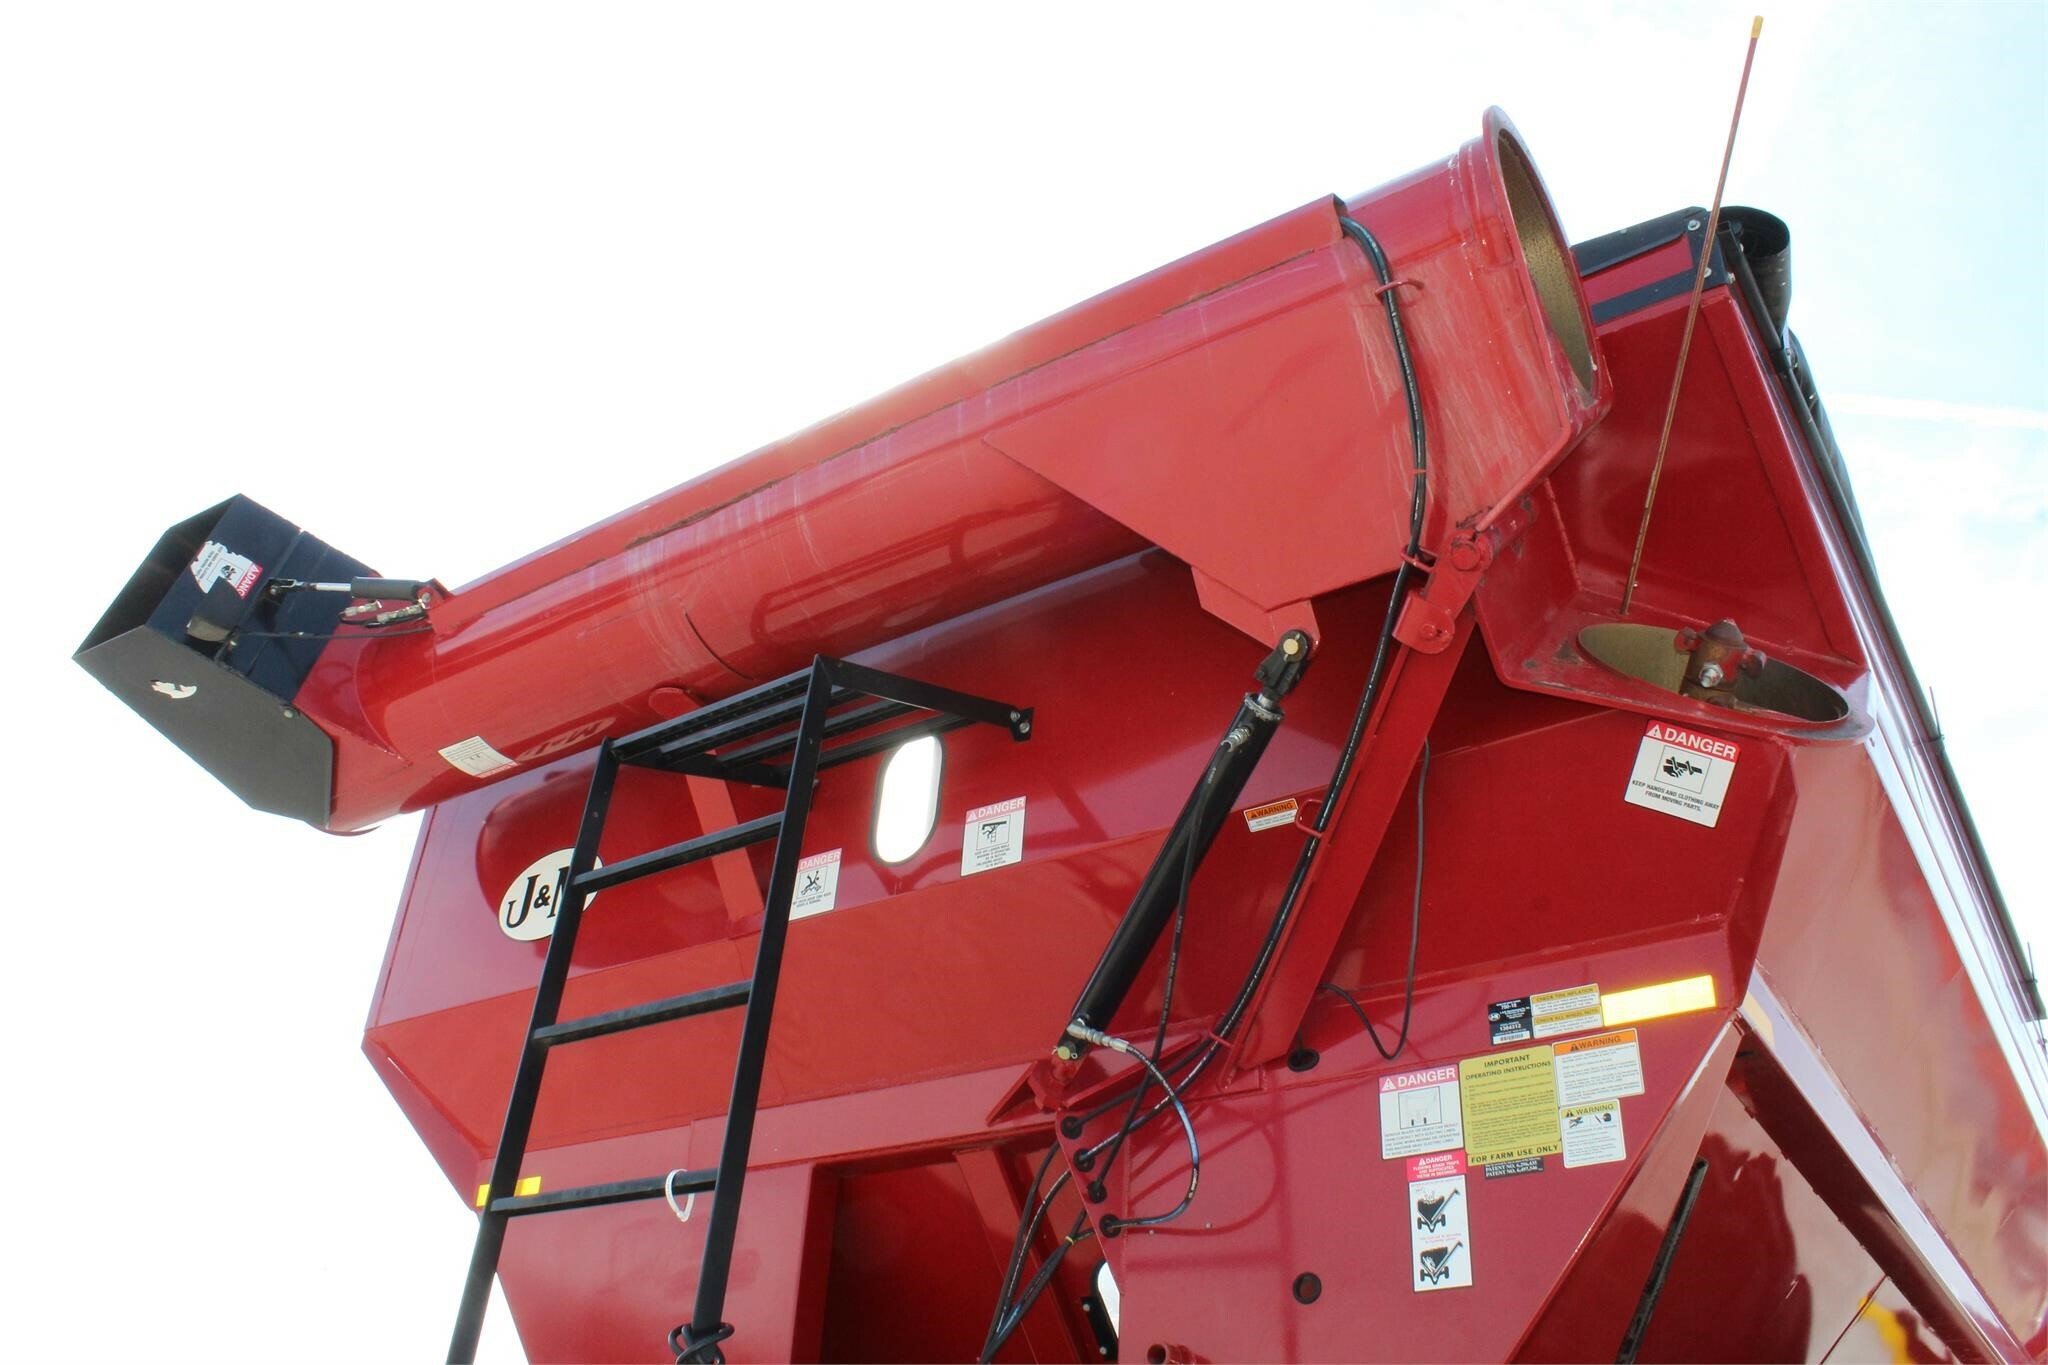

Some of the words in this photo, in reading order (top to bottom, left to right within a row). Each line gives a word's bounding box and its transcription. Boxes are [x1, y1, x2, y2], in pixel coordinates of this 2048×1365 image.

[1664, 727, 1737, 759] DANGER
[1632, 779, 1646, 788] KEEP
[1647, 784, 1665, 794] HANDS
[1665, 789, 1677, 798] AND
[1678, 793, 1704, 806] CLOTHING
[1704, 801, 1720, 810] AWAY
[1645, 790, 1661, 800] FROM
[1661, 795, 1682, 806] MOVING
[978, 798, 1025, 818] DANGER
[1257, 801, 1294, 816] WARNING
[800, 851, 841, 870] DANGER
[1579, 1036, 1621, 1049] WARNING
[1484, 1054, 1530, 1068] IMPORTANT
[1398, 1067, 1456, 1088] DANGER
[1465, 1069, 1502, 1081] OPERATING
[1503, 1061, 1551, 1074] INSTRUCTIONS
[1576, 1103, 1614, 1115] WARNING
[1425, 1154, 1453, 1164] DANGER
[1471, 1156, 1487, 1164] FOR
[1490, 1152, 1514, 1161] FARM
[1517, 1148, 1532, 1156] USE
[1536, 1144, 1559, 1154] ONLY
